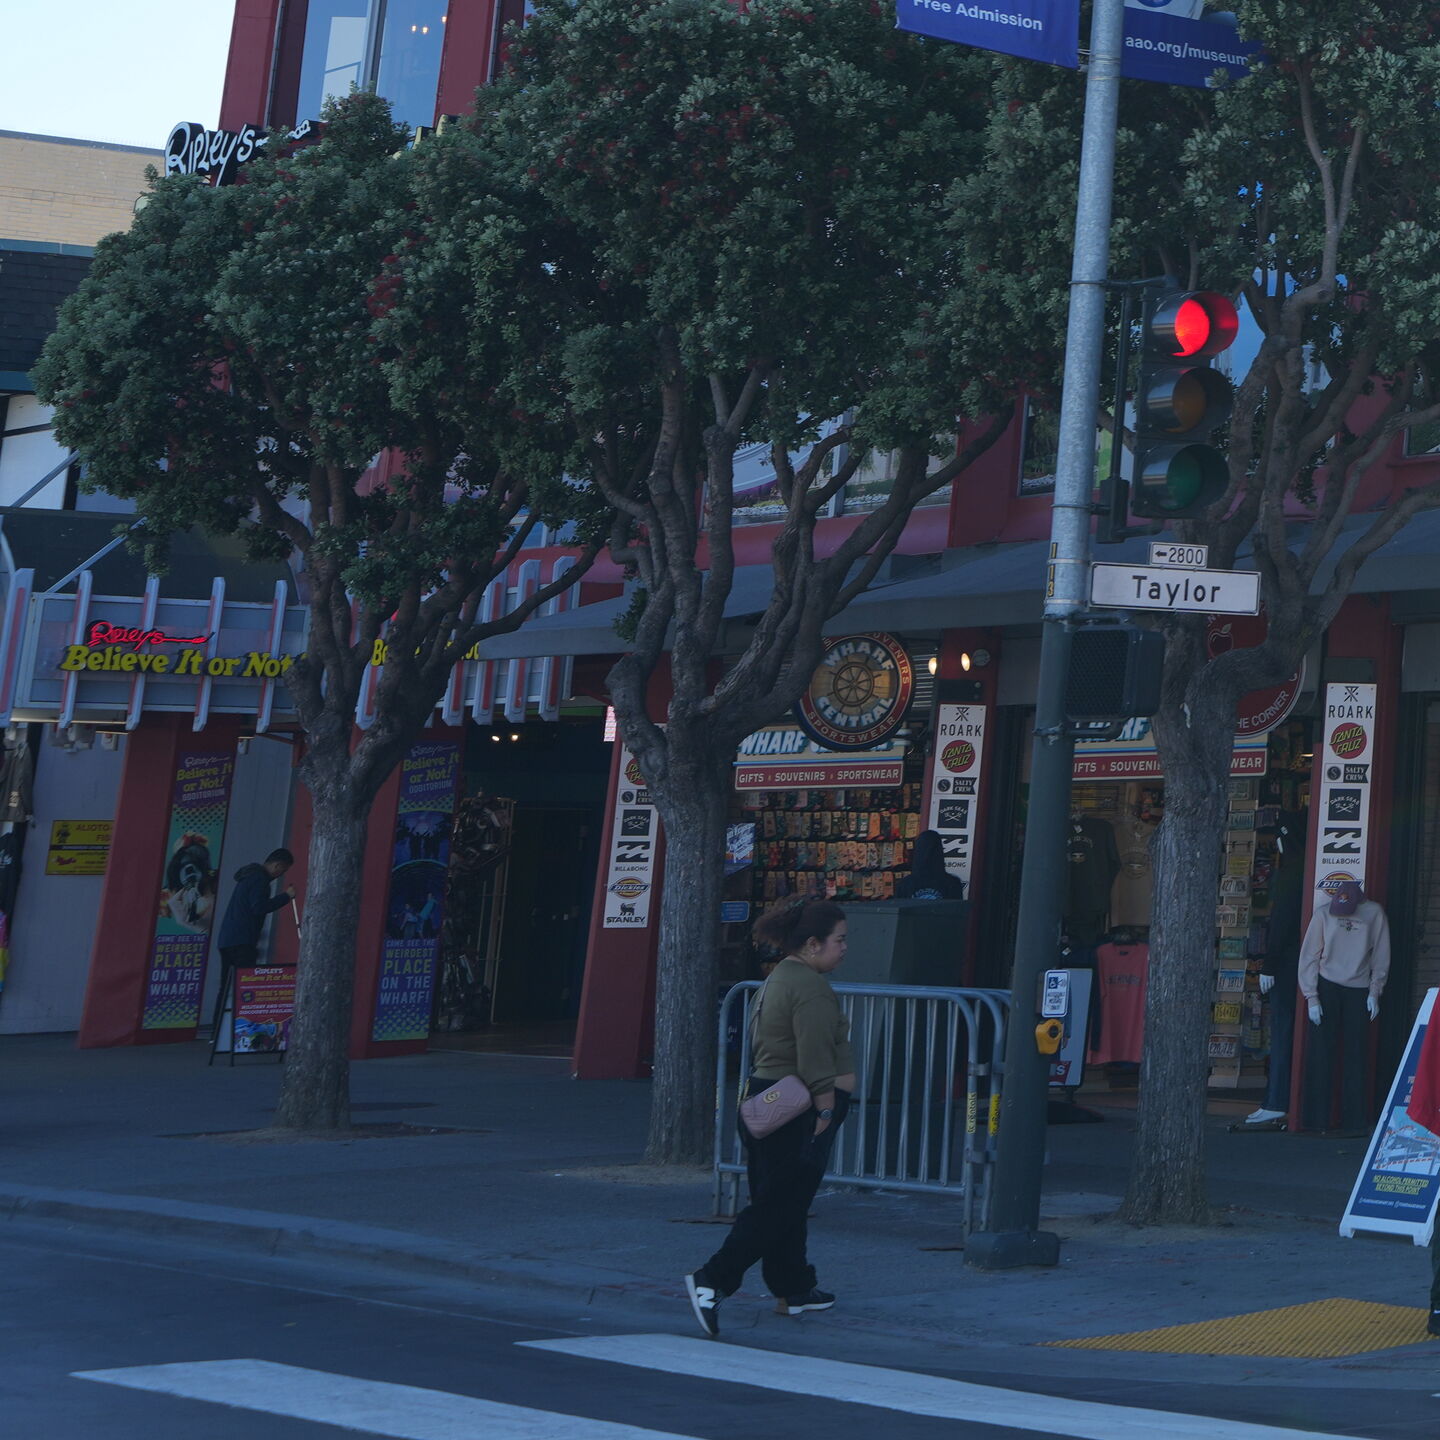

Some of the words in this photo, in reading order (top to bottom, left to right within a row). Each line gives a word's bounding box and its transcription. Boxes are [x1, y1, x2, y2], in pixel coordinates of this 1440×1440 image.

[956, 2, 1043, 32] Admission
[1126, 35, 1248, 66] aao.org/museum
[1168, 547, 1204, 565] 2800
[1132, 575, 1221, 606] Taylor
[61, 645, 169, 672] Believe
[174, 649, 203, 675] It
[208, 658, 240, 677] or
[825, 642, 895, 671] WHARF
[817, 696, 894, 727] CENTRAL
[1236, 718, 1249, 729] HE
[1251, 690, 1290, 727] CORNER
[1328, 705, 1373, 719] ROARK
[807, 711, 896, 743] SPORTSWEAR
[940, 724, 982, 737] ROARK
[740, 731, 807, 755] WHARF
[1330, 725, 1364, 746] SANTA
[941, 742, 974, 760] SANTA
[1335, 738, 1362, 756] CRUZ
[403, 756, 446, 772] Believe
[945, 753, 971, 770] CRUZ
[1074, 762, 1097, 773] IFTS
[1110, 762, 1162, 773] SOUVENI
[409, 772, 425, 783] or
[739, 773, 764, 783] GIFTS
[774, 771, 826, 782] SOUVENIRS
[836, 769, 899, 780] SPORTSWEAR
[1345, 766, 1365, 774] SALTY
[1345, 773, 1364, 781] CREW
[183, 781, 196, 792] or
[606, 916, 645, 924] STANLEY
[156, 943, 205, 954] WEIRDEST
[385, 947, 434, 958] WEIRDEST
[154, 953, 202, 968] PLACE
[383, 958, 432, 975] PLACE
[152, 969, 170, 982] ON
[176, 967, 200, 981] THE
[151, 982, 199, 996] WHARF!
[381, 976, 399, 990] ON
[406, 975, 431, 989] THE
[379, 990, 430, 1005] WHARF!
